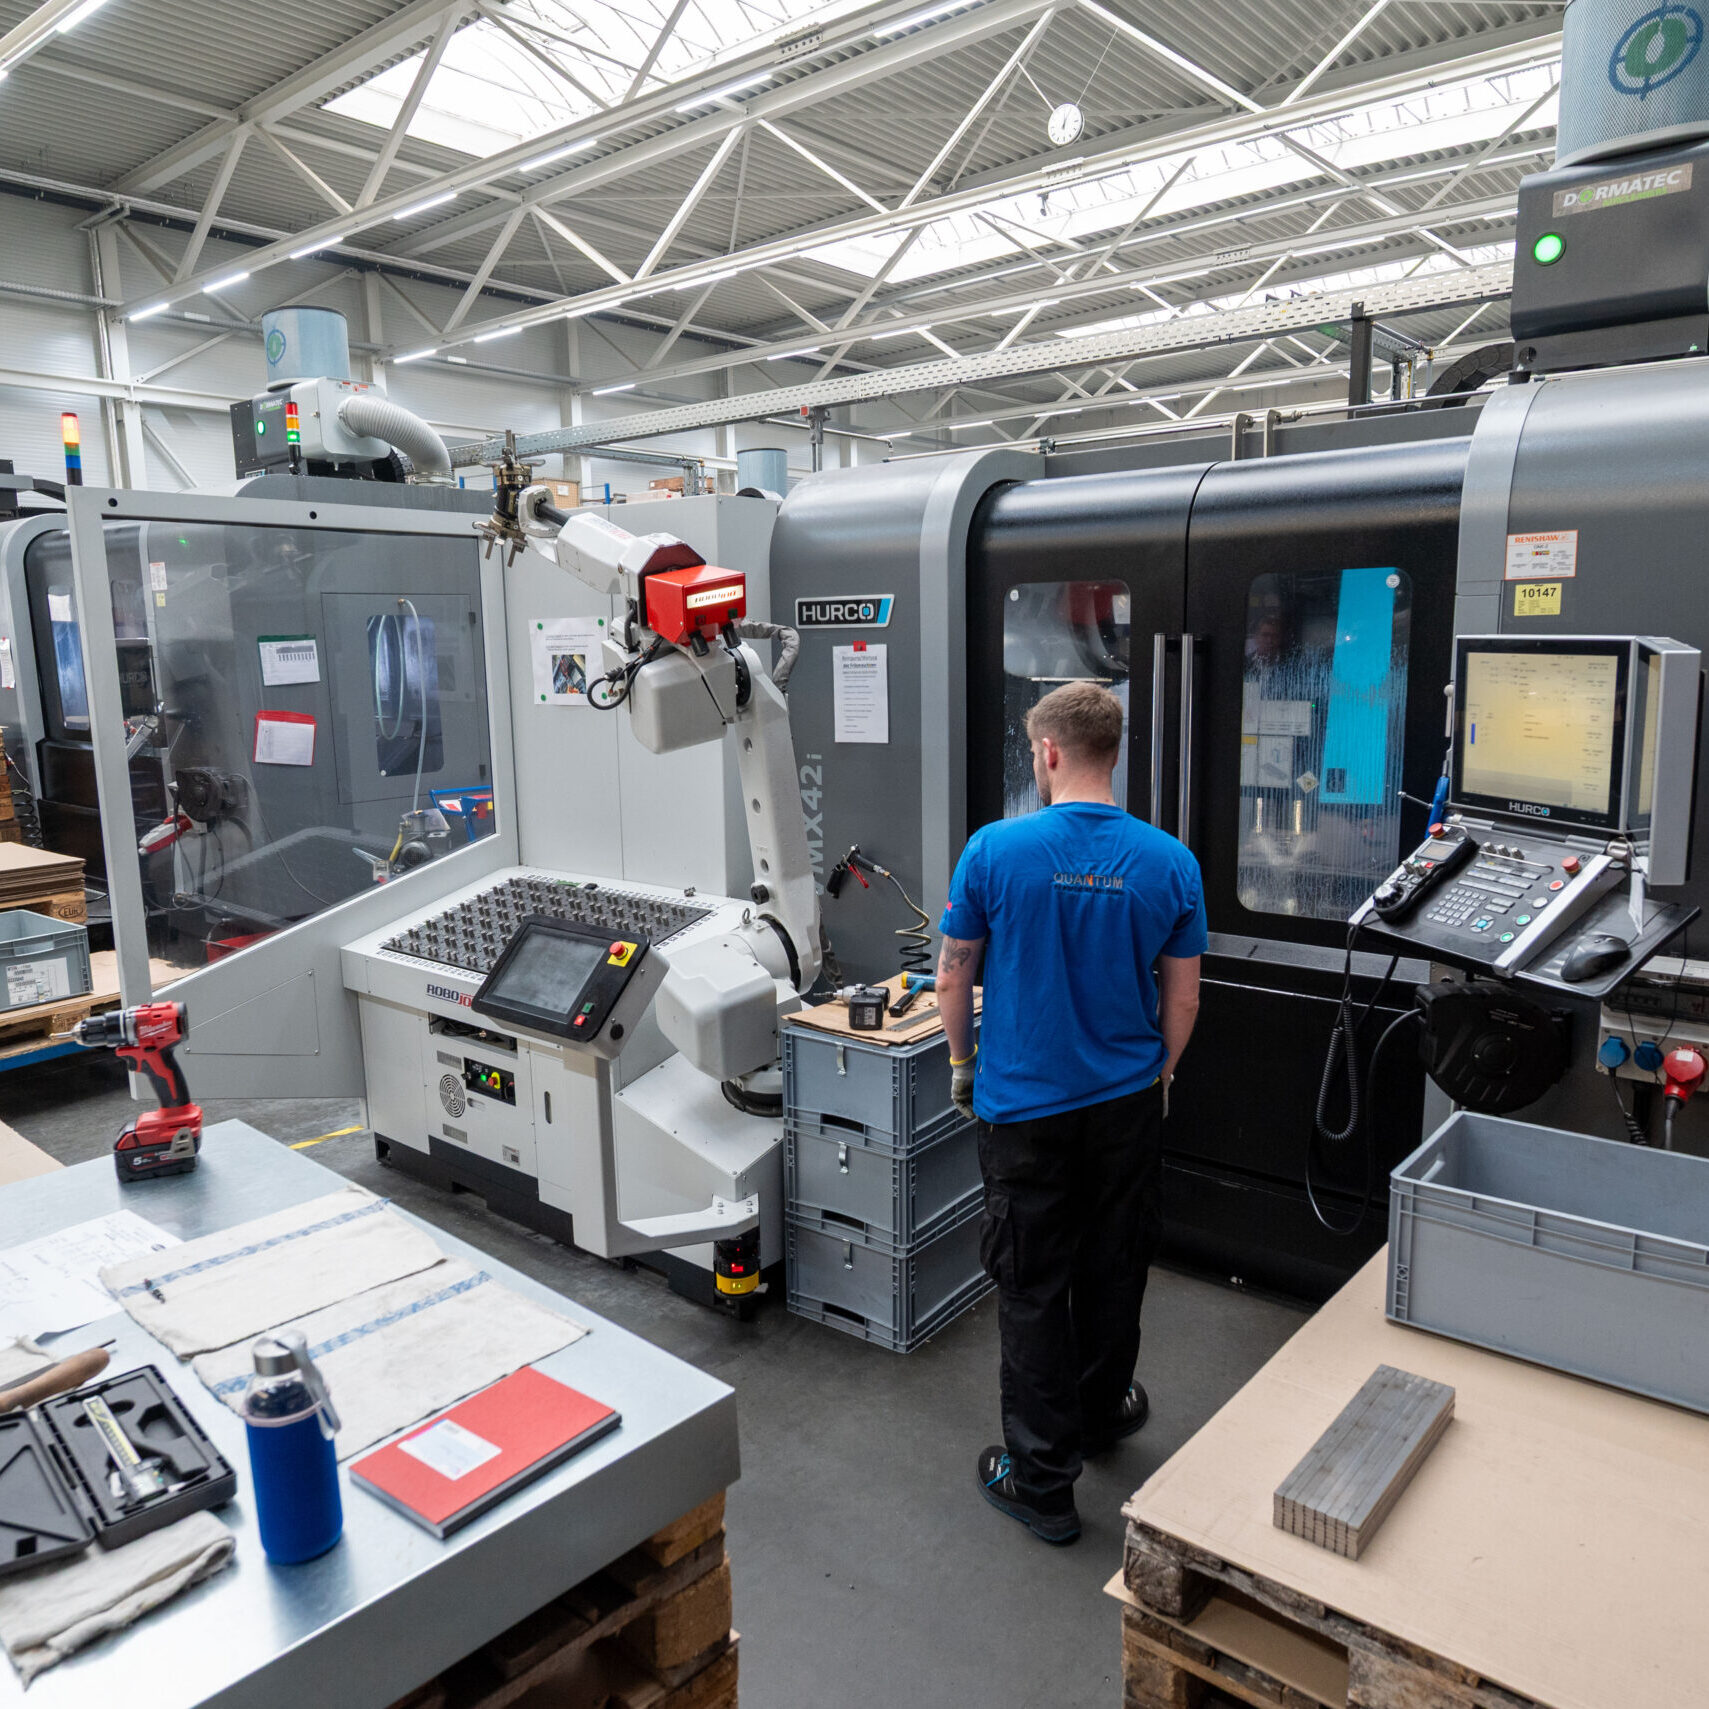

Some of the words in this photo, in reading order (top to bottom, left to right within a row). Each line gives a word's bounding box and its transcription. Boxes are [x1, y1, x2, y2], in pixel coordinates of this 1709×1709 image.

[1563, 170, 1682, 207] DORMATEC
[1521, 587, 1557, 598] 10147
[802, 603, 874, 621] HURCO
[1509, 801, 1550, 817] HURCO
[1053, 872, 1123, 889] QUANTUM
[427, 984, 472, 1007] ROBOJO
